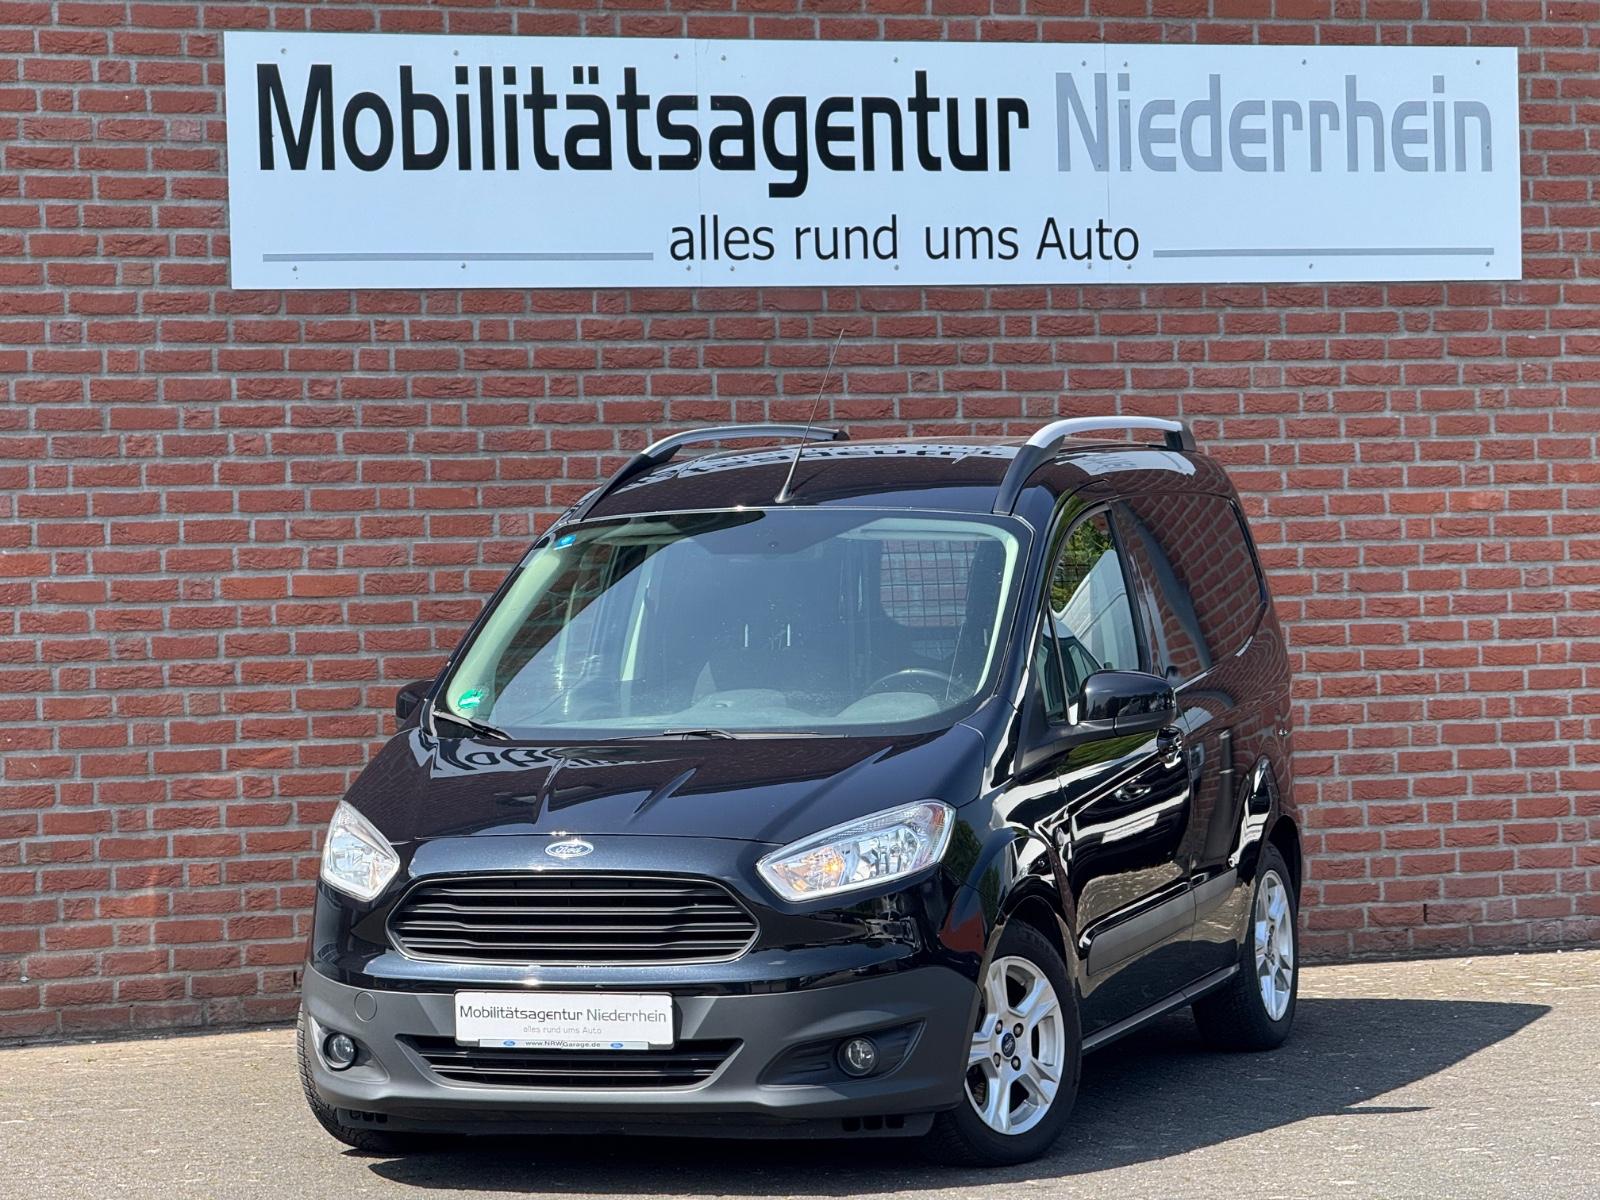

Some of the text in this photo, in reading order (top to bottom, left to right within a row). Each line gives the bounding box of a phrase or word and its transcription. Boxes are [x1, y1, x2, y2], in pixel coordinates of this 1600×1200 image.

[257, 64, 1493, 199] Mobilitätsagentur Niederrhein
[670, 214, 1139, 260] alles rund ums Auto
[459, 1005, 667, 1023] Mobilitätsagentur Niederrhein
[523, 1025, 541, 1034] alles
[543, 1026, 561, 1034] rund
[582, 1026, 602, 1035] Auto
